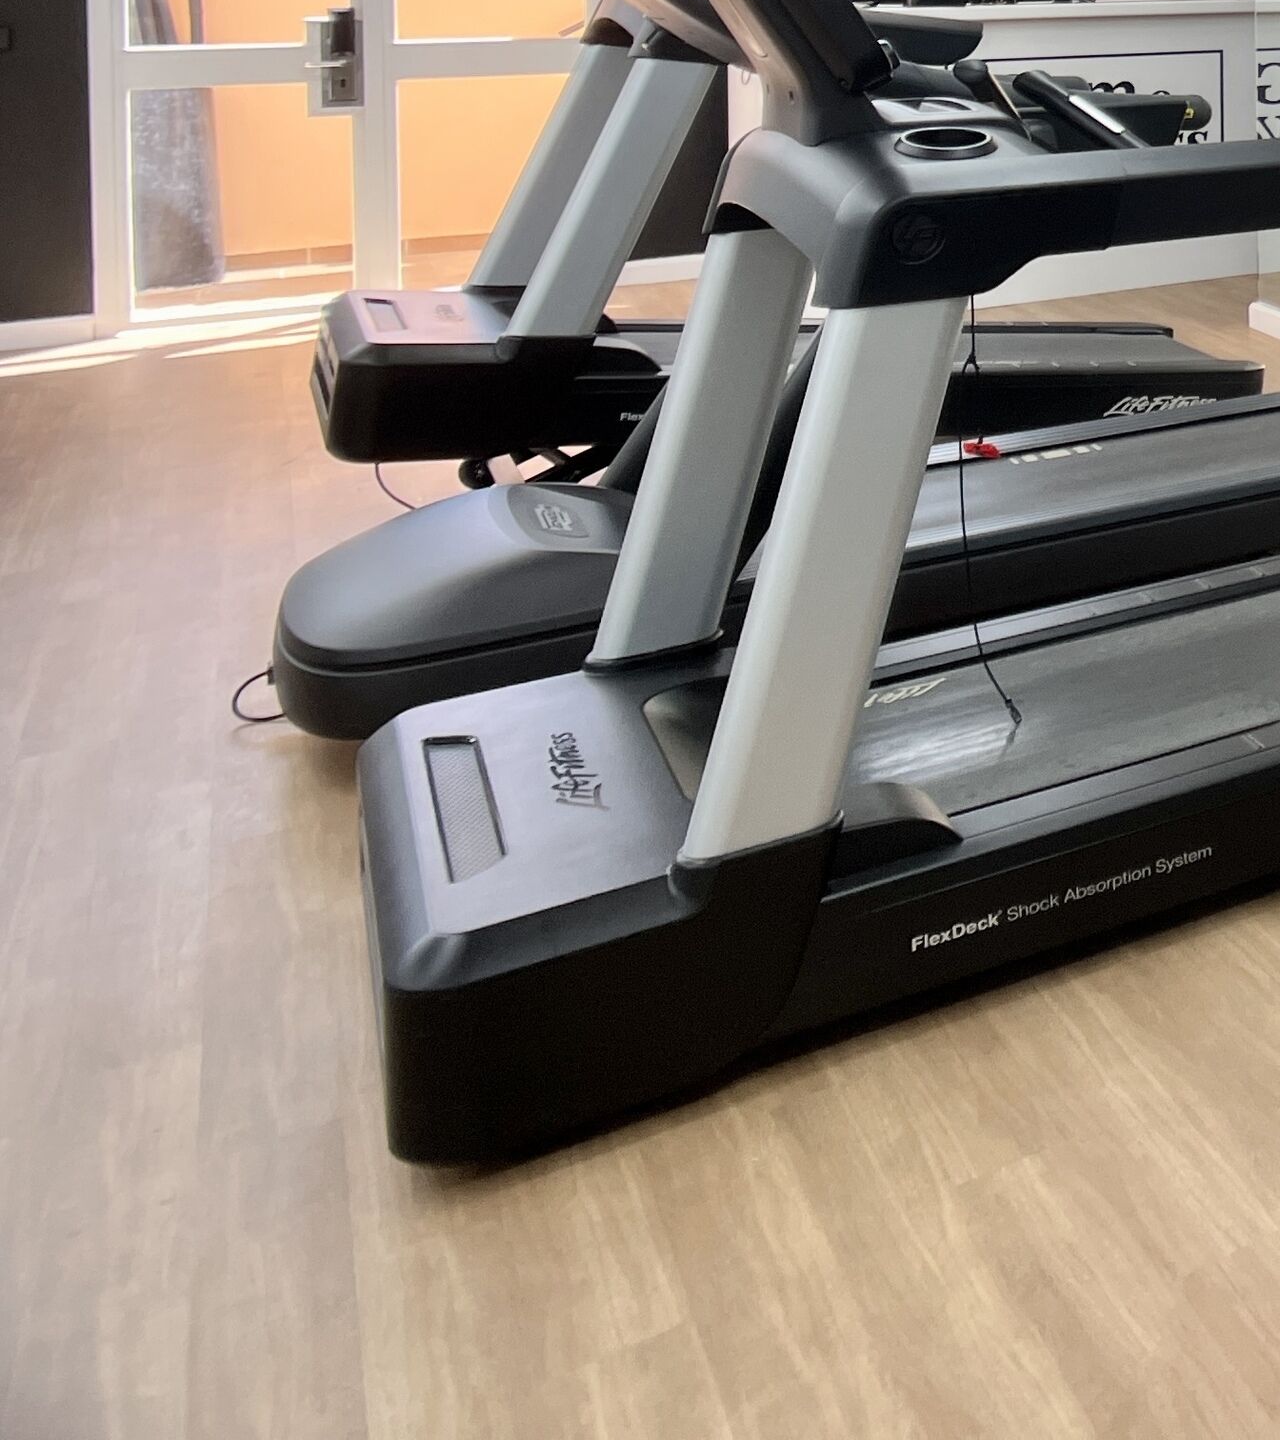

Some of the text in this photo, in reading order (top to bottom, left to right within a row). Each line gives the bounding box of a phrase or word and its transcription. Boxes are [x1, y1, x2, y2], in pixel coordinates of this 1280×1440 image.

[1006, 893, 1060, 922] Shock
[1063, 865, 1152, 904] Absorption
[1155, 846, 1213, 875] System
